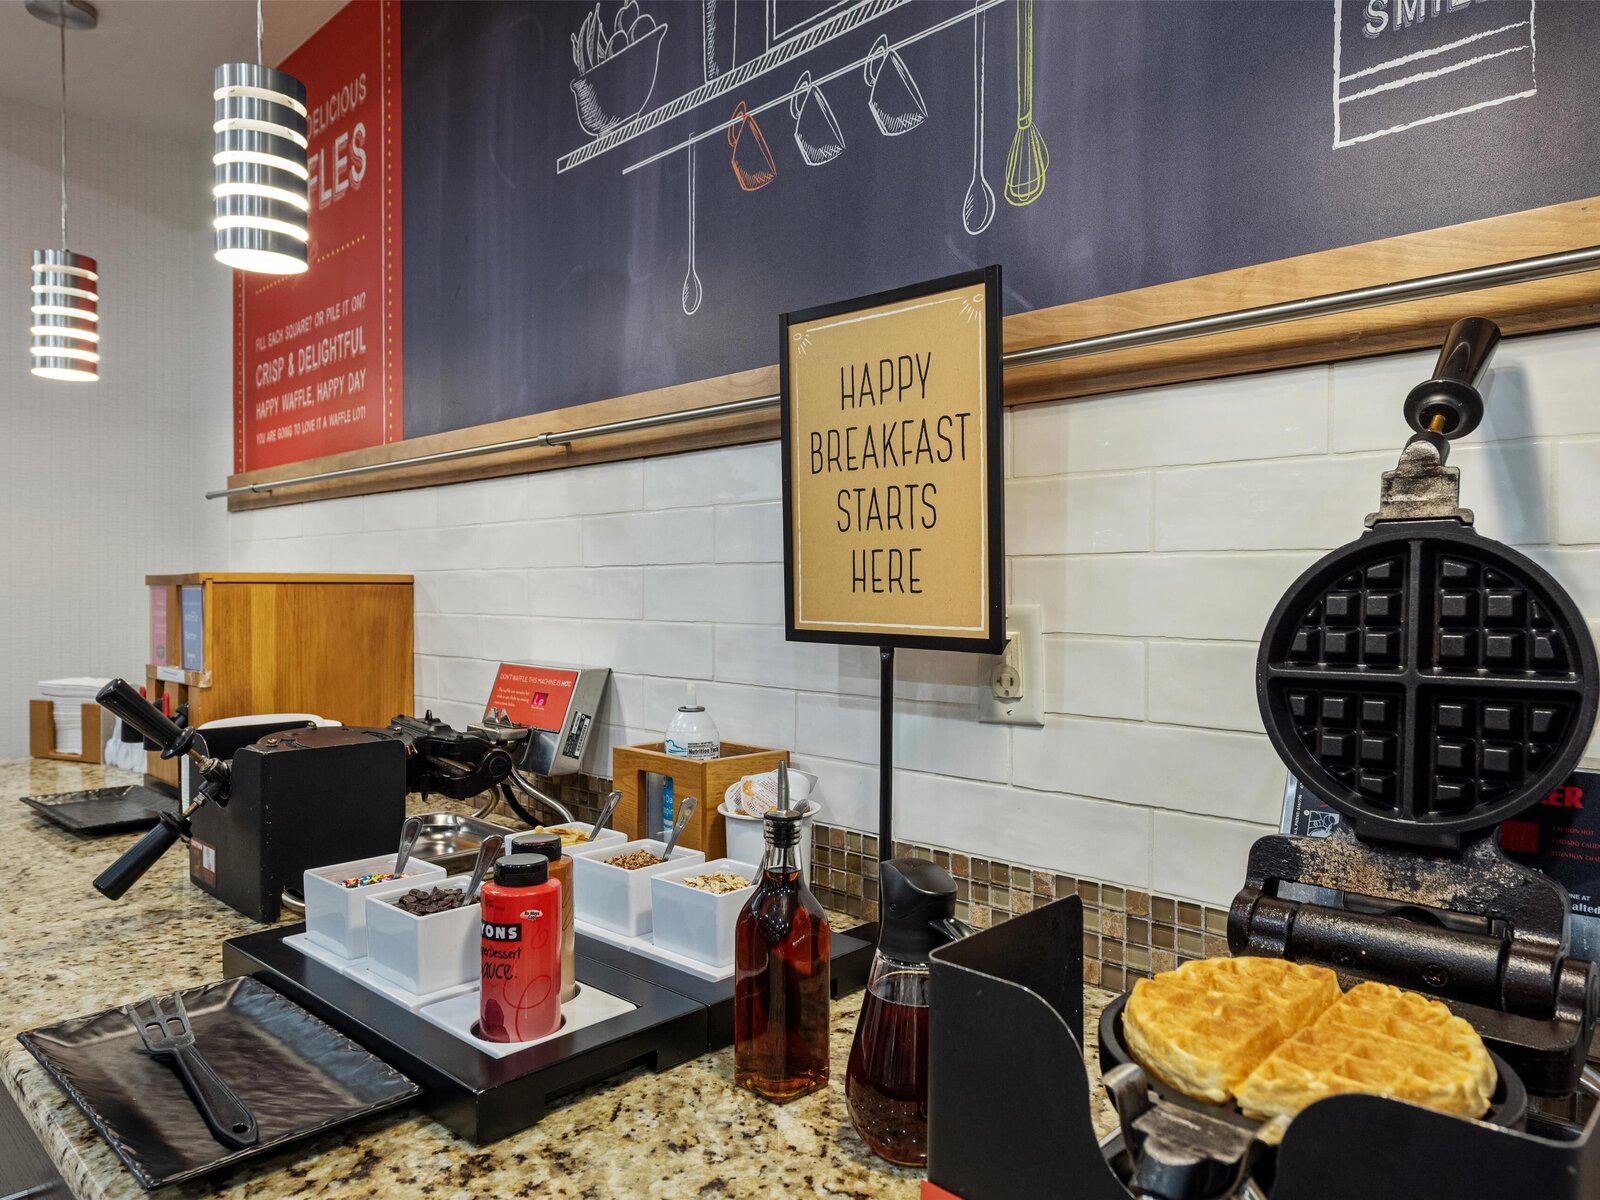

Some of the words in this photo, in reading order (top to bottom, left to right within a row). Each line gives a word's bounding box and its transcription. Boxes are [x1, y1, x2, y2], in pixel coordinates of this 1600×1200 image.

[256, 336, 267, 352] FILL
[268, 328, 284, 348] EACH
[285, 314, 313, 341] SQUARE?
[314, 310, 325, 328] OR
[326, 303, 341, 323] PILE
[342, 299, 350, 317] IT
[351, 291, 367, 312] ON?
[256, 356, 285, 389] CRISP
[288, 352, 295, 378] &
[298, 325, 367, 376] DELIGHTFUL
[840, 351, 932, 411] HAPPY
[256, 396, 279, 420] HAPPY
[281, 385, 315, 412] WAFFLE,
[317, 375, 345, 403] HAPPY
[347, 368, 367, 395] DAY
[256, 432, 266, 445] YOU
[266, 429, 276, 443] ARE
[277, 424, 293, 440] GOING
[294, 422, 301, 436] TO
[301, 418, 315, 434] LOVE
[316, 417, 322, 430] IT
[322, 415, 328, 429] A
[329, 409, 351, 427] WAFFLE
[352, 405, 367, 422] LOT!
[810, 412, 971, 475] BREAKFAST
[837, 482, 937, 532] STARTS
[852, 547, 923, 593] HERE
[1541, 784, 1584, 809] ER
[480, 923, 518, 940] YONS
[1572, 903, 1600, 915] alted
[481, 961, 513, 980] auce
